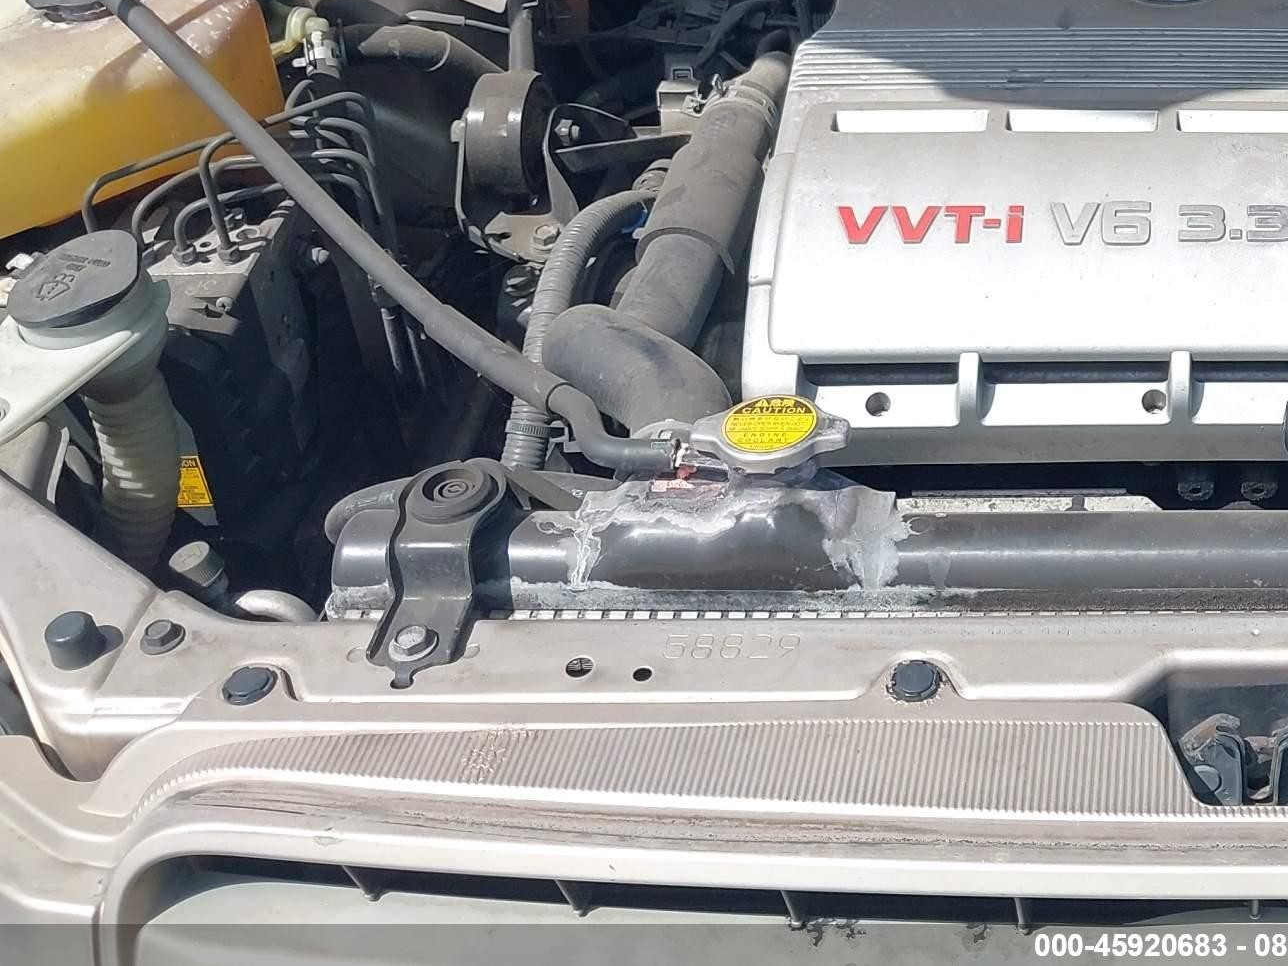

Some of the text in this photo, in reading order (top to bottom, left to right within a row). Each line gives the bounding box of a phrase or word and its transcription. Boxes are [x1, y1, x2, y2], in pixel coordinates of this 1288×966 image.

[837, 204, 1025, 245] VVT-i
[1049, 200, 1152, 246] V6
[663, 633, 801, 659] 58829
